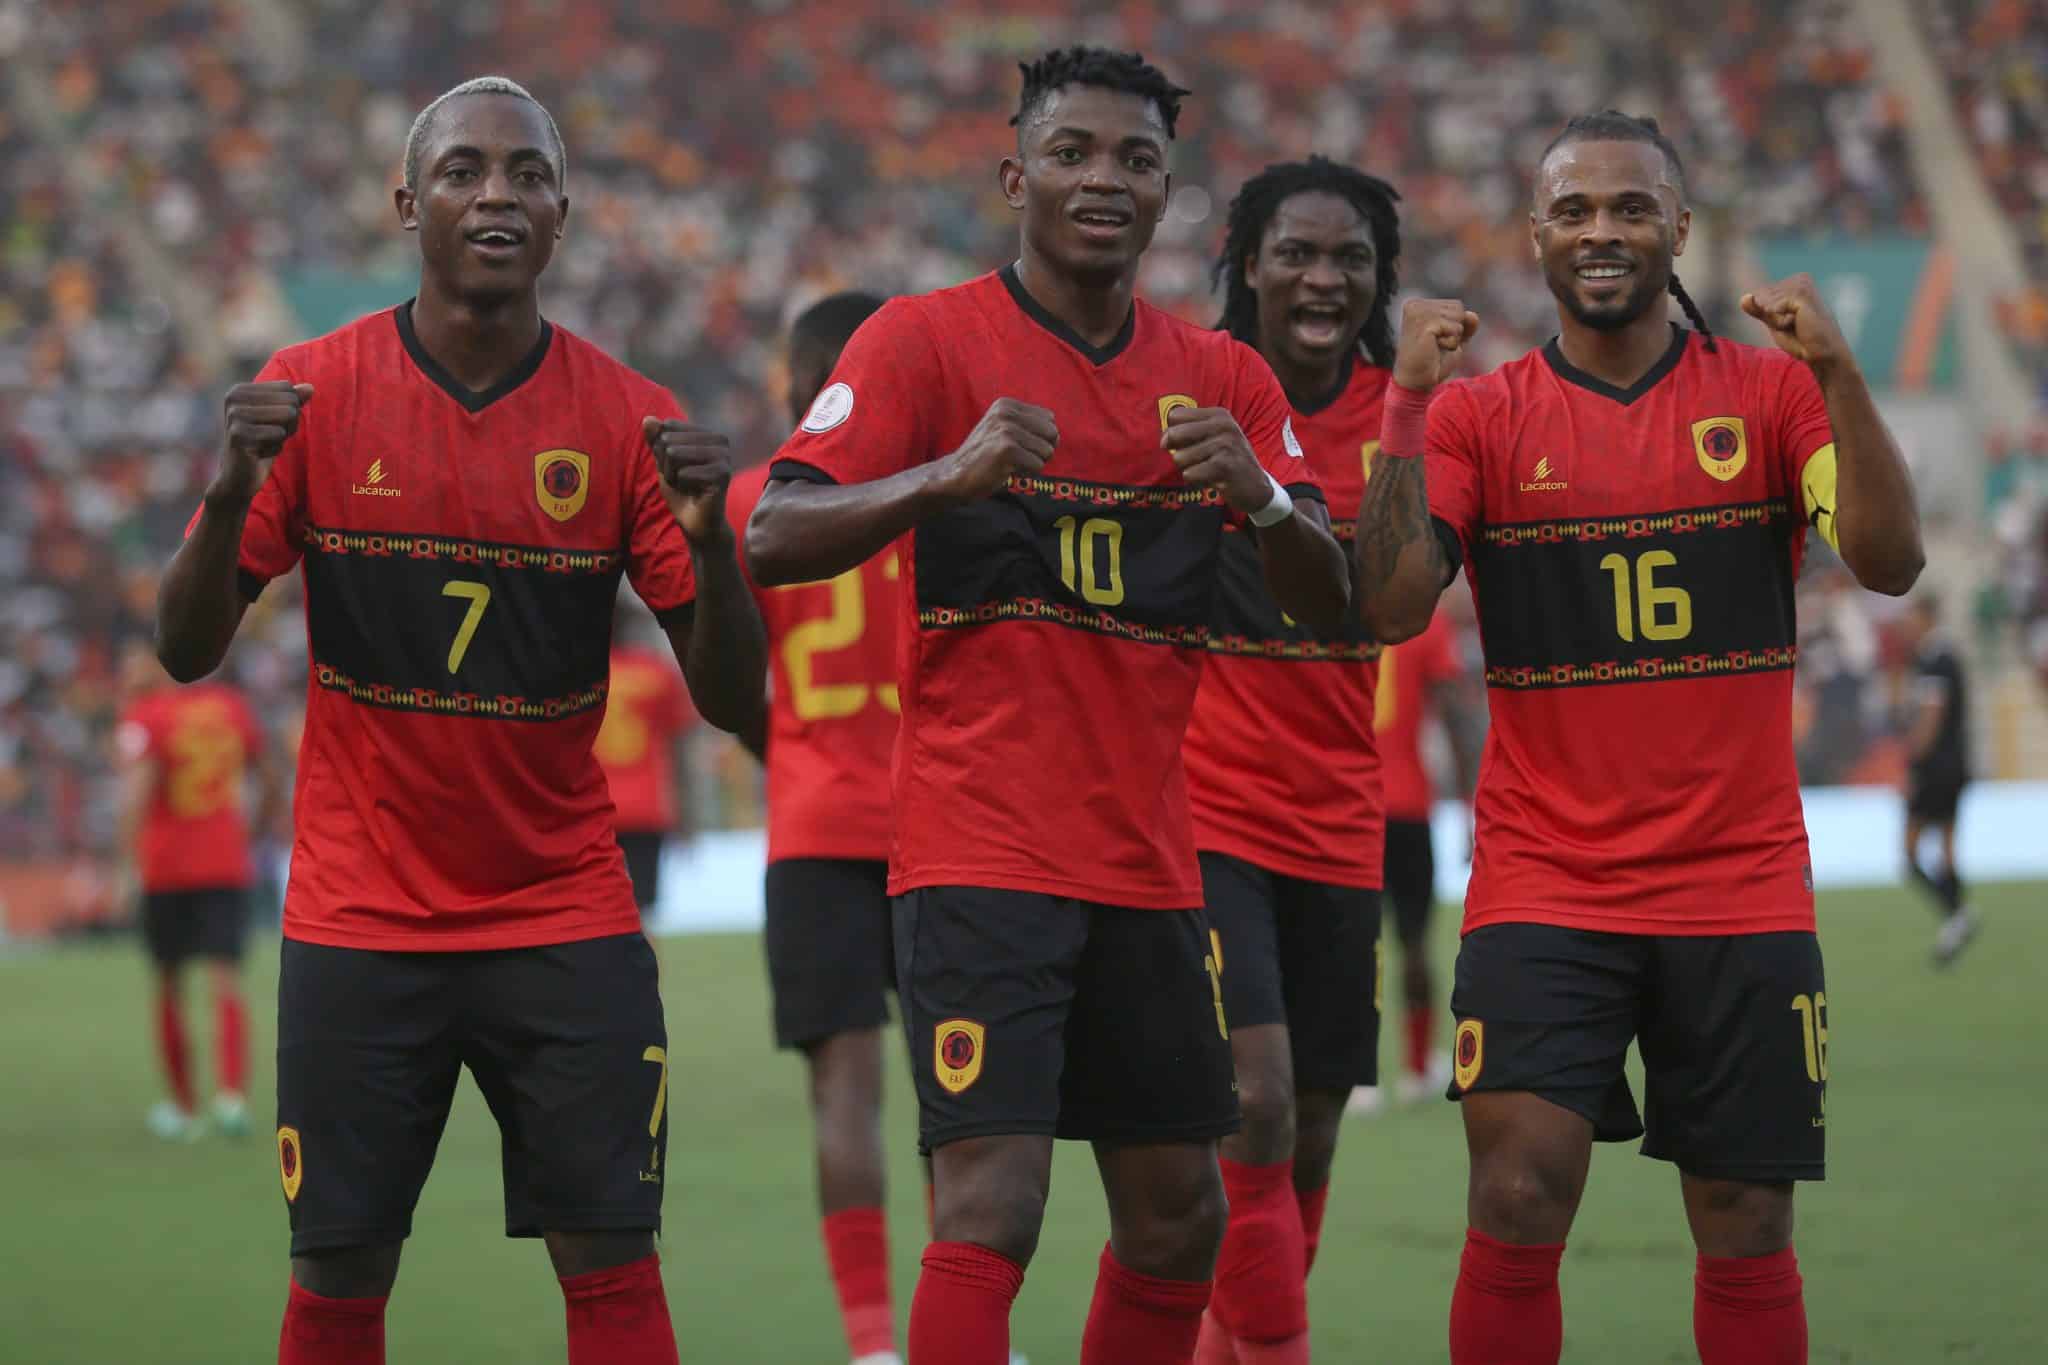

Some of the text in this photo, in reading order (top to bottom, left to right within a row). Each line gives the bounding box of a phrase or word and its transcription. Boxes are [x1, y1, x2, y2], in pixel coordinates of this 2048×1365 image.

[352, 481, 401, 497] Lacatoni
[1520, 481, 1568, 492] Lacatoni
[1053, 515, 1124, 606] 10
[1600, 549, 1692, 642] 16
[441, 580, 490, 674] 7
[775, 552, 900, 720] 2
[642, 1045, 668, 1138] 7
